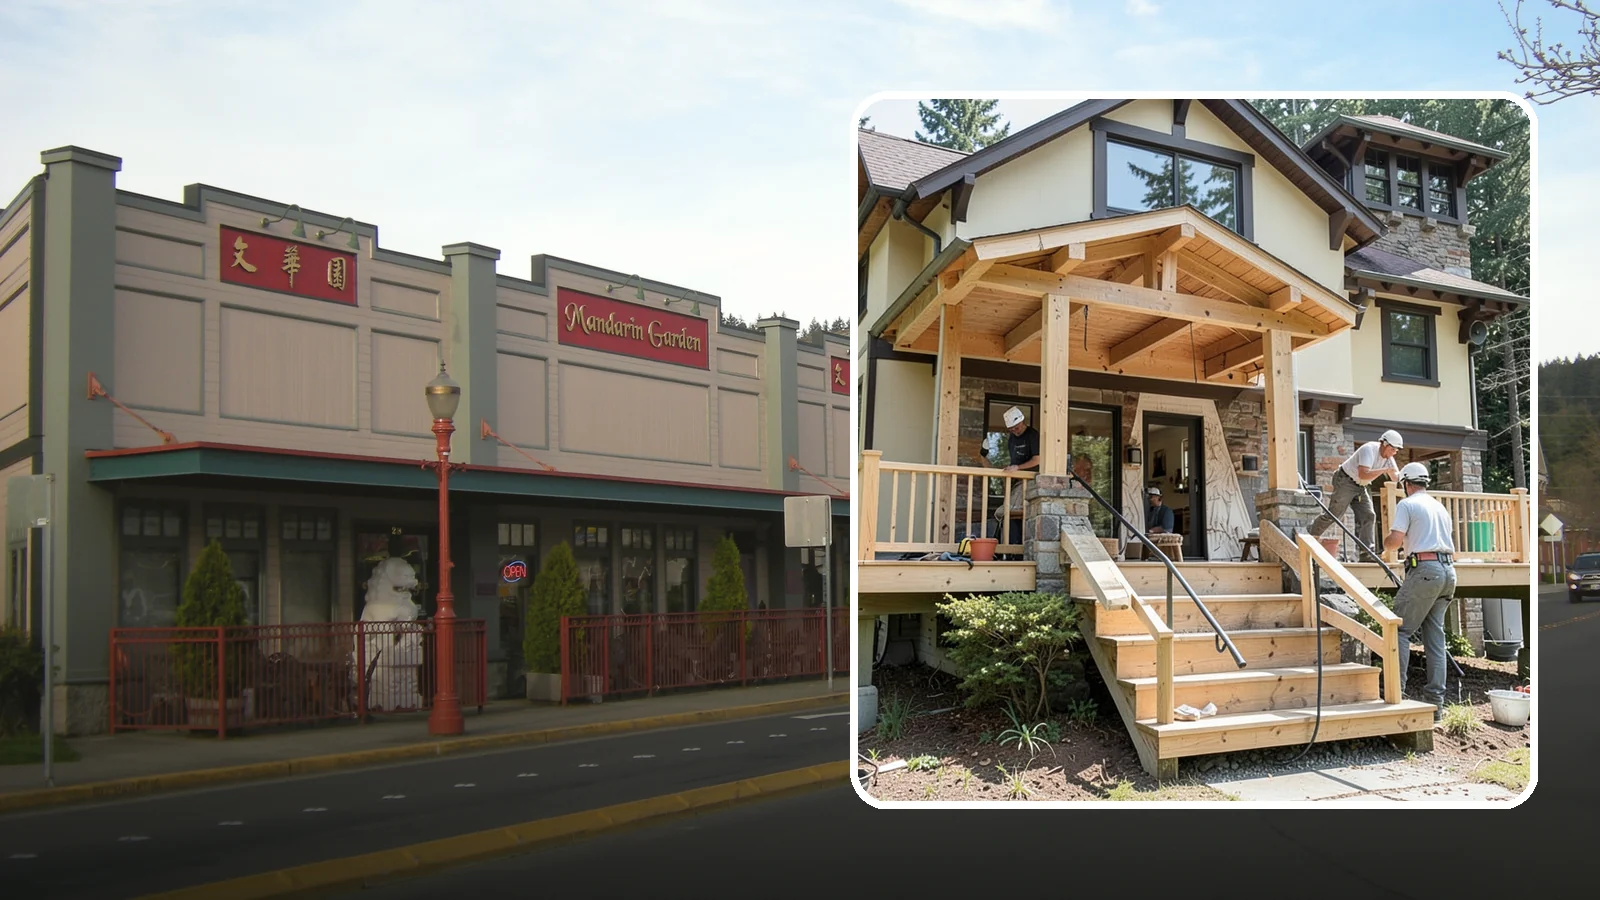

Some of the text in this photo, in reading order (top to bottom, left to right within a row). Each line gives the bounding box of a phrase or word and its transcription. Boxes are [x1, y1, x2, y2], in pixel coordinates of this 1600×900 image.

[231, 236, 346, 291] 文華園
[564, 302, 702, 352] Mandarin Garden
[503, 565, 527, 578] OPEN
